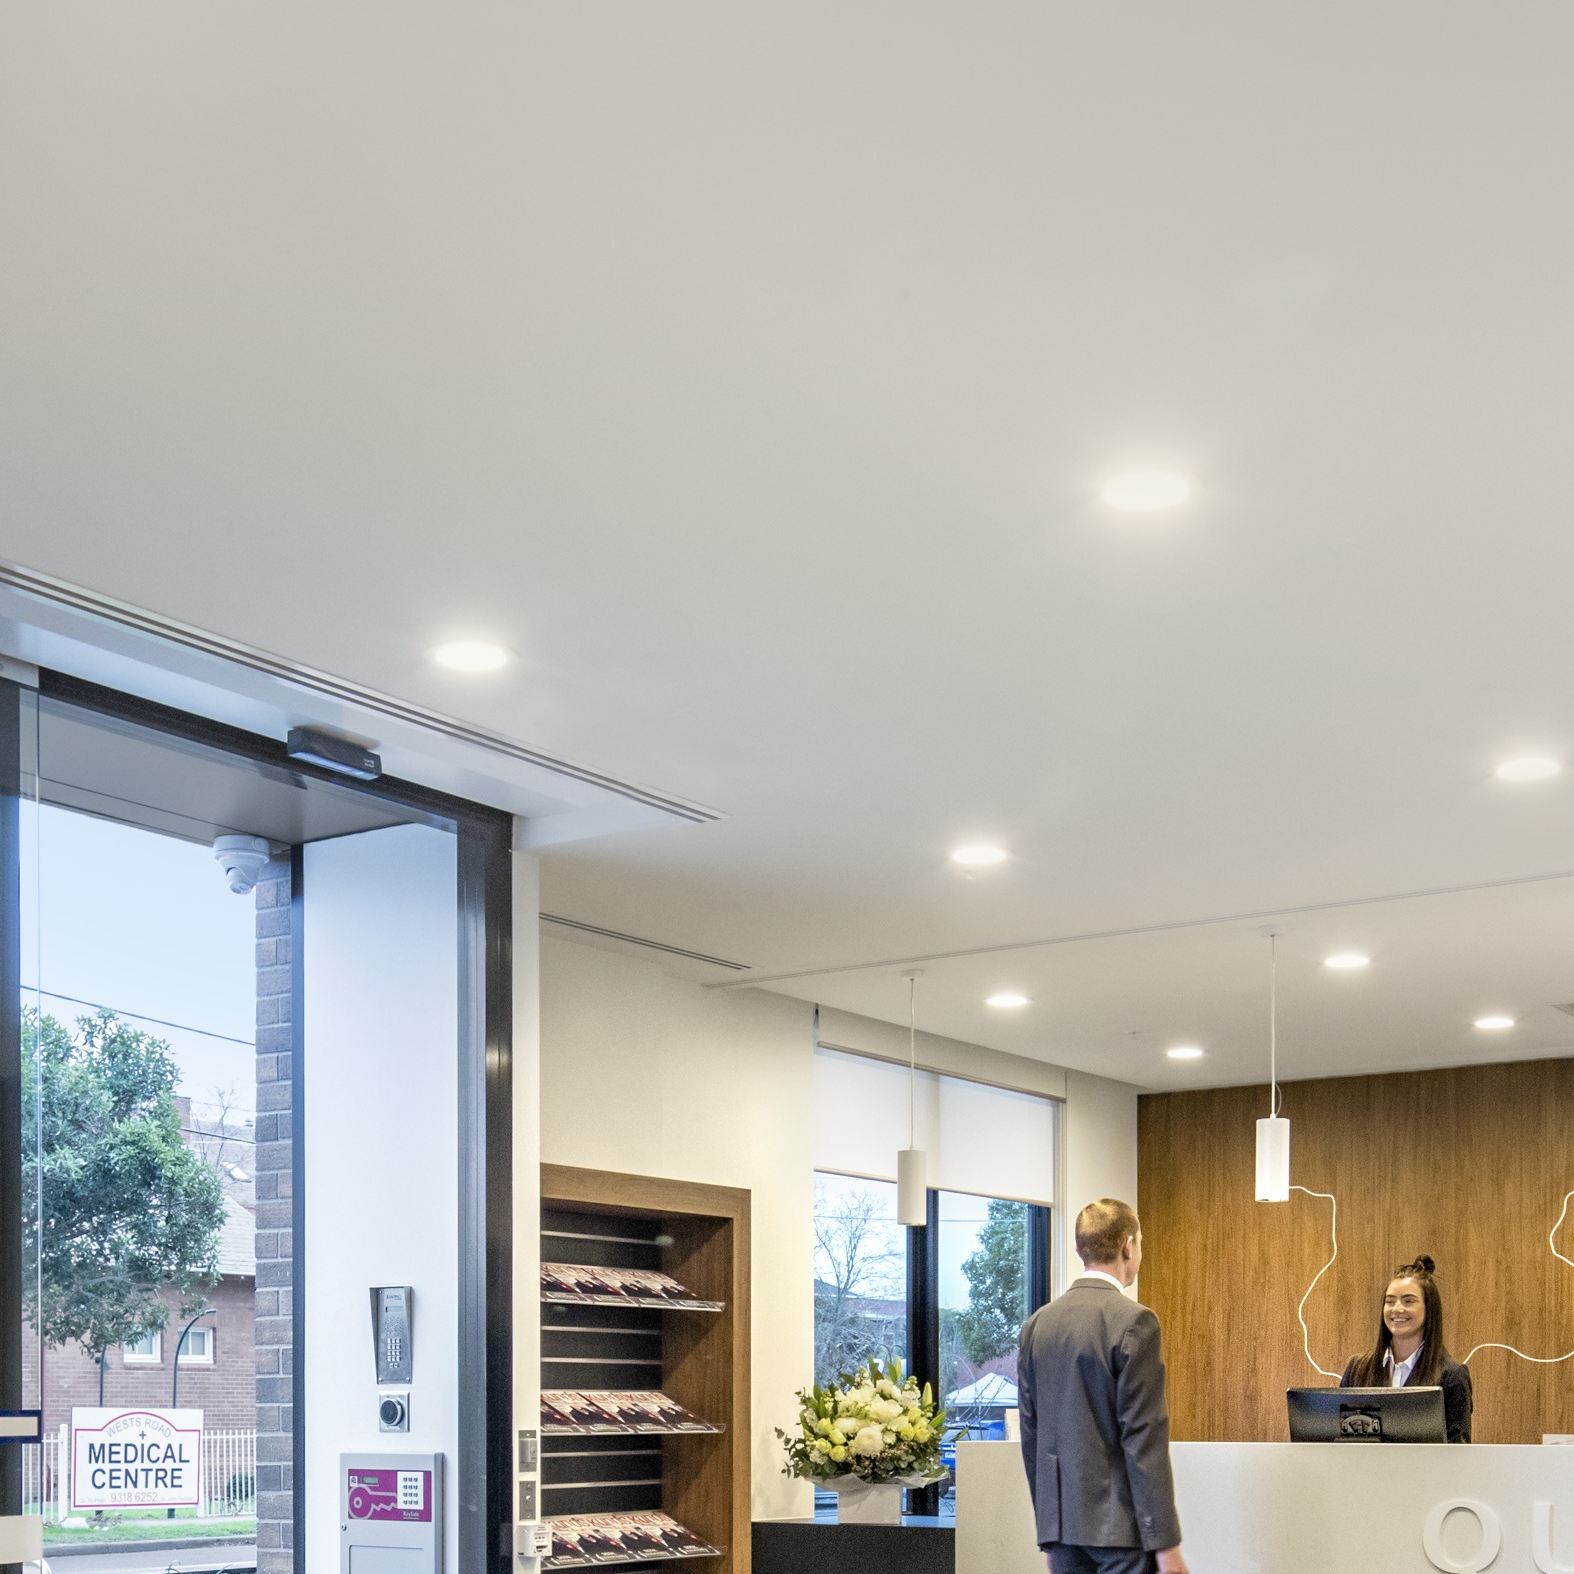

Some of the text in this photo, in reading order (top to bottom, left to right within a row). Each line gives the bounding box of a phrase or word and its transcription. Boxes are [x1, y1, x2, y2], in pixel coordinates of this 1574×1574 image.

[105, 1417, 172, 1438] WESTS ROAD
[88, 1443, 190, 1464] MEDICAL
[91, 1468, 183, 1490] CENTRE
[110, 1492, 133, 1502] 9318
[134, 1491, 158, 1502] 6252
